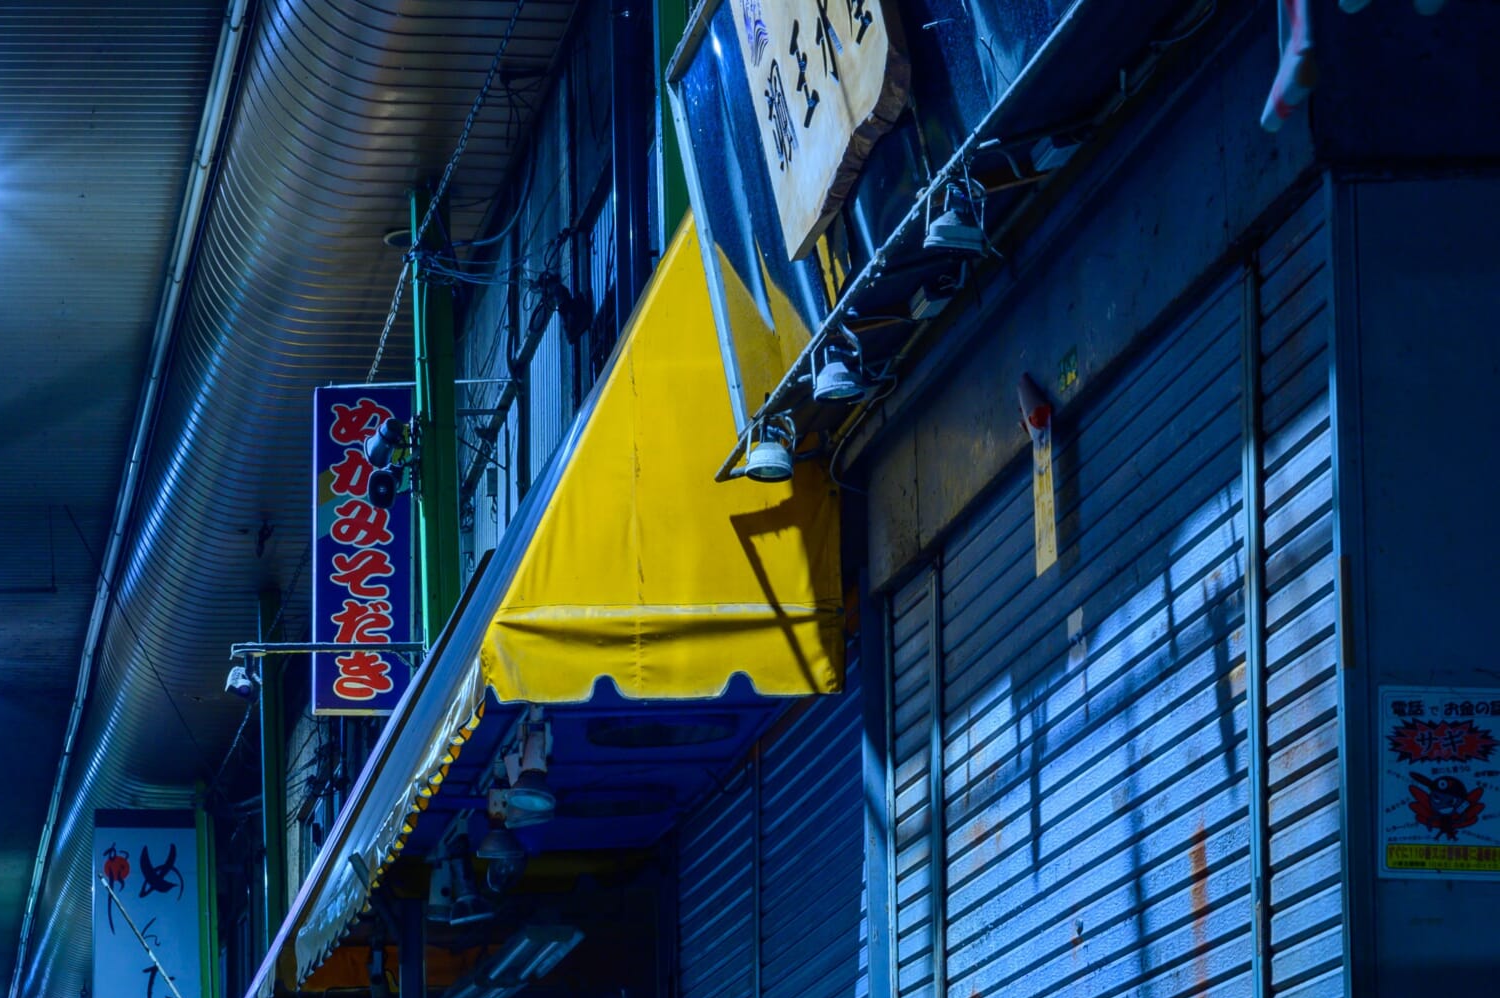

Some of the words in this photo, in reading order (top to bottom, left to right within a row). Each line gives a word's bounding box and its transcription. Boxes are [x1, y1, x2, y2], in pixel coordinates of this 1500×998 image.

[330, 398, 395, 702] ぬかみそだき
[1416, 730, 1464, 753] サギ
